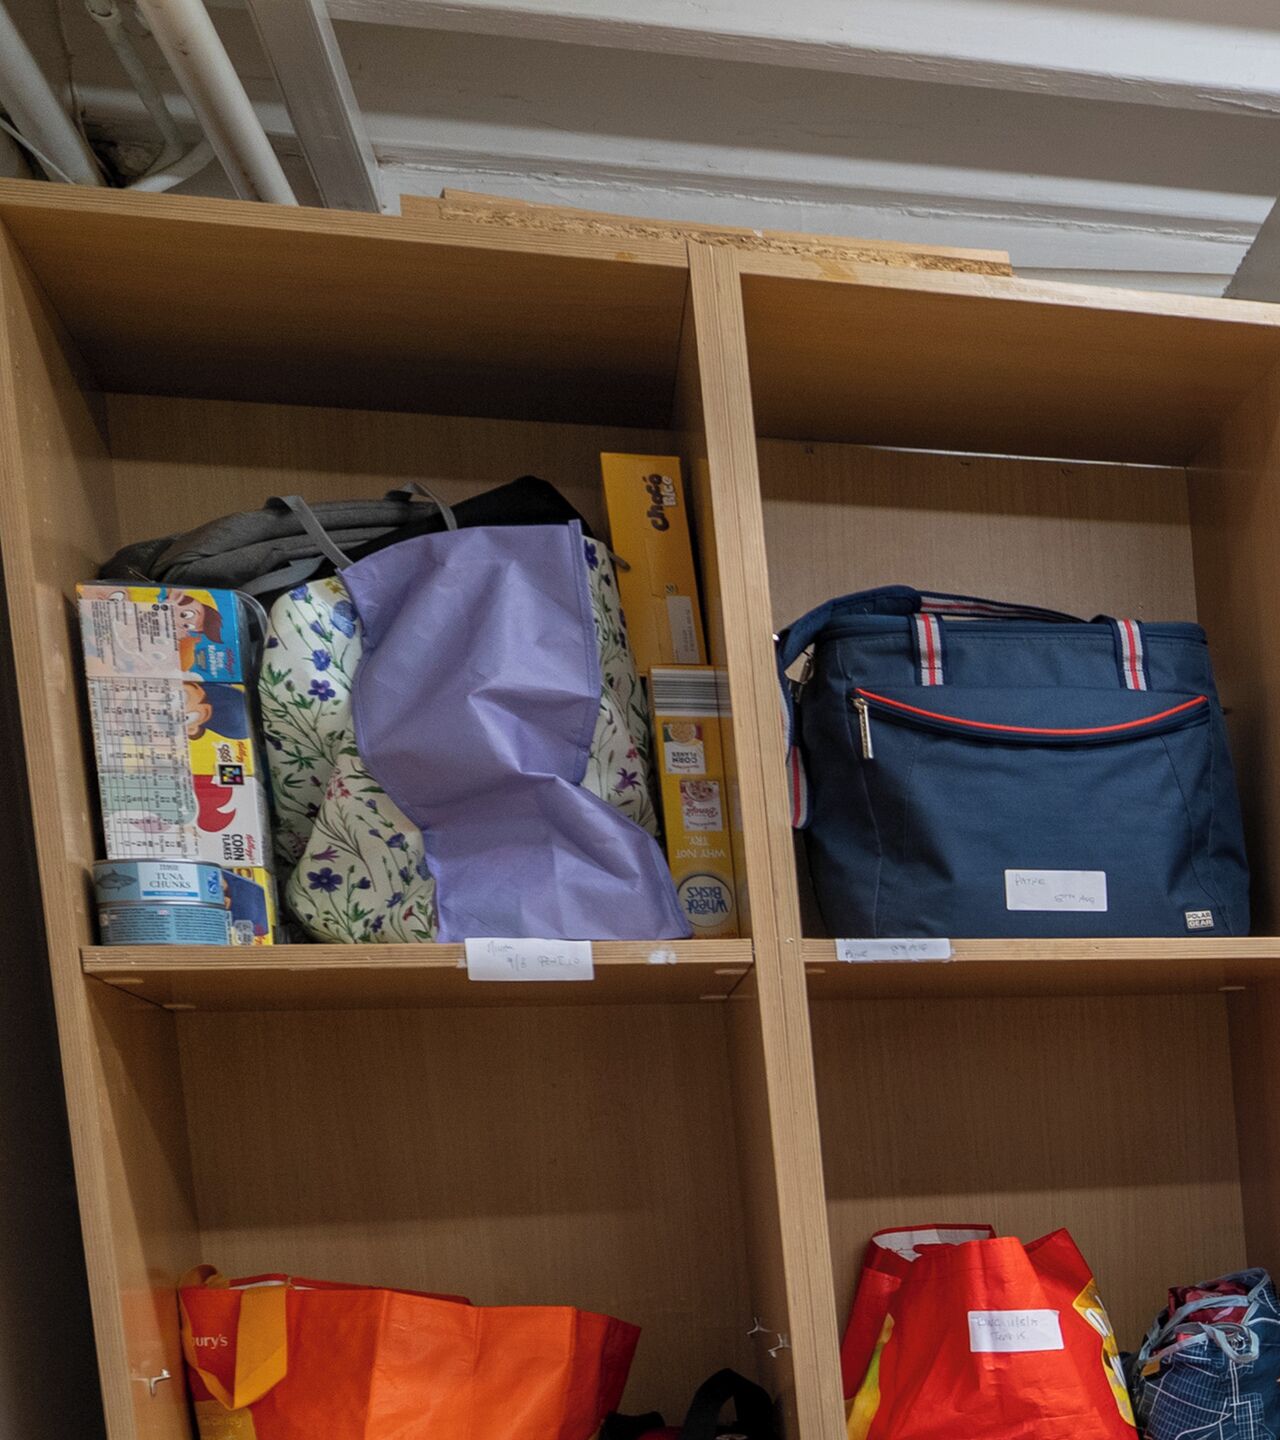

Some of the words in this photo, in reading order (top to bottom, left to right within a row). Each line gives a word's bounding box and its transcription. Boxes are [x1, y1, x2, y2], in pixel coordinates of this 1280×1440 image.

[222, 834, 232, 861] FLAKES
[231, 834, 244, 861] CORN
[675, 848, 698, 858] NOT
[700, 848, 726, 858] WHY
[155, 872, 184, 880] TUNA
[150, 880, 191, 888] CHUNKS
[685, 898, 728, 914] Wheat
